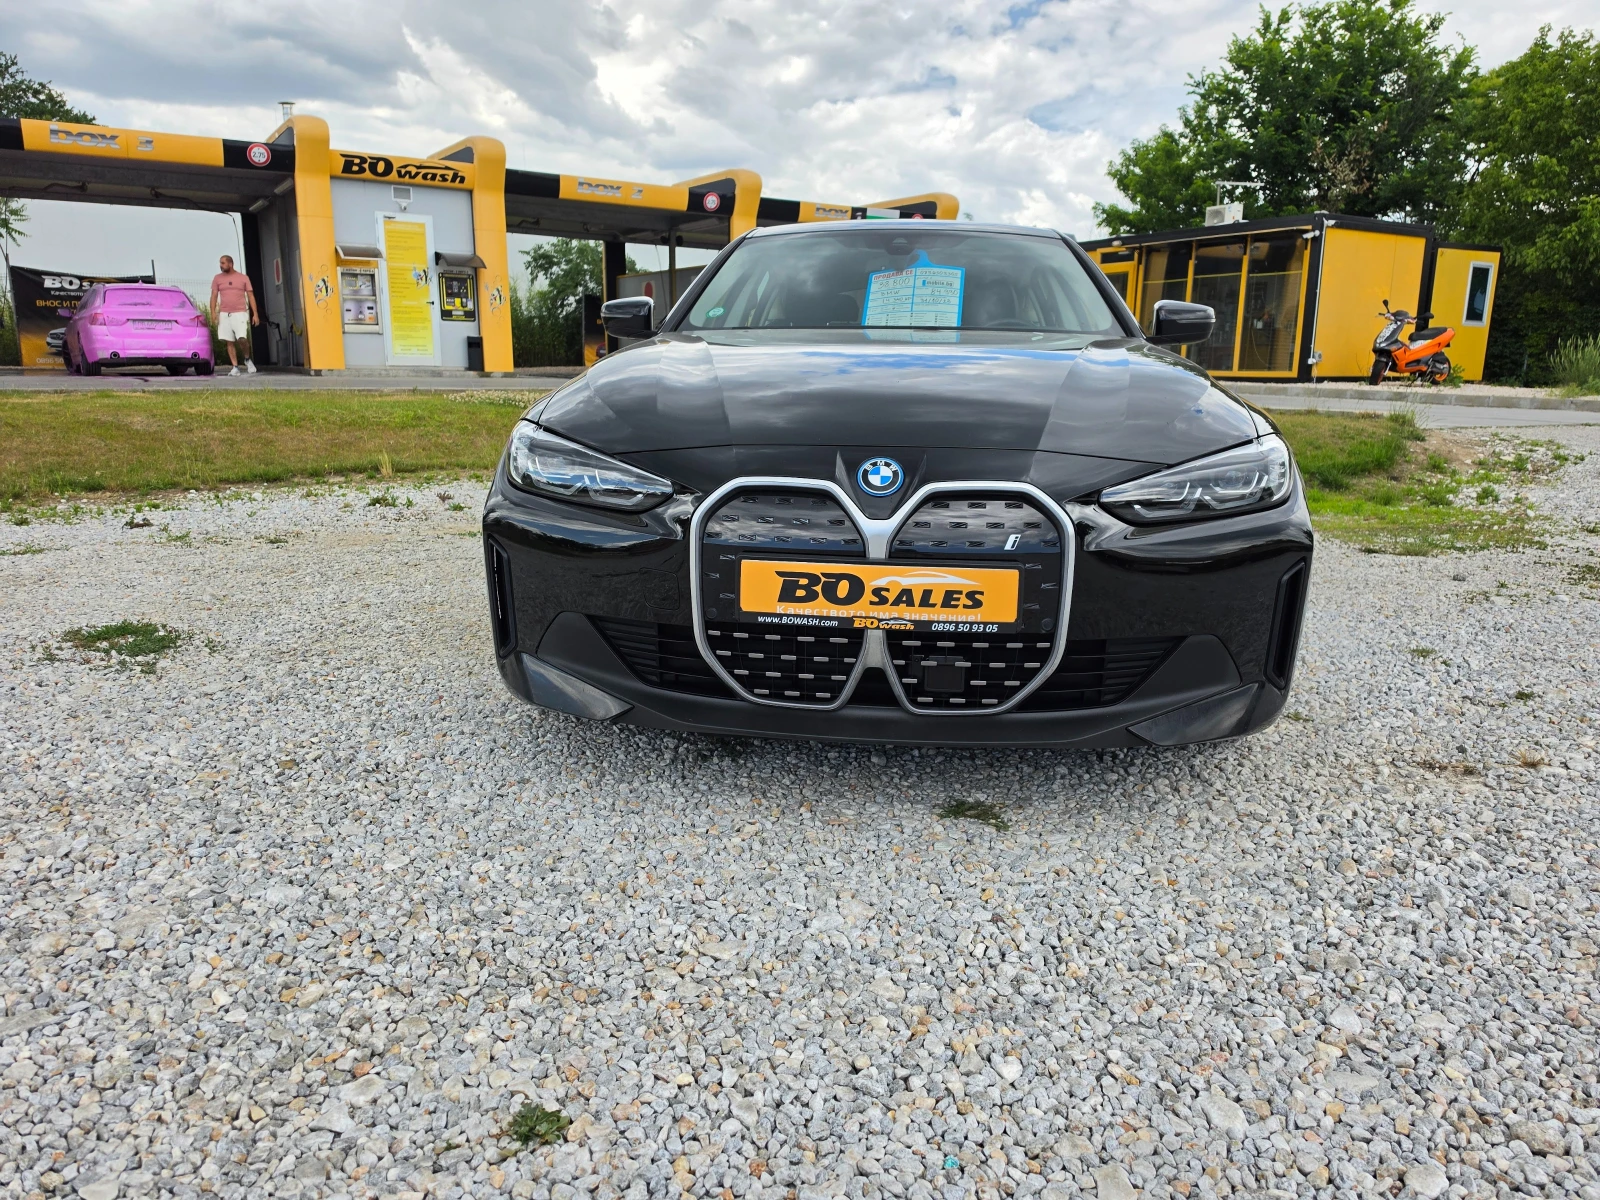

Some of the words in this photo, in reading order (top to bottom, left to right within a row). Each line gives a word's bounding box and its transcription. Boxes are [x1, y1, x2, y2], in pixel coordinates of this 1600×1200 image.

[49, 124, 120, 149] box
[137, 136, 154, 151] 3
[396, 169, 466, 184] wash
[577, 177, 622, 197] box
[631, 186, 643, 199] 2
[36, 299, 61, 307] ВНОС
[774, 570, 866, 606] BO
[869, 587, 985, 609] SALES
[757, 615, 839, 627] www.BOWASH.com
[776, 605, 866, 617] Качеството
[869, 611, 899, 619] има
[902, 612, 982, 622] значение!
[931, 622, 956, 632] 0896
[957, 623, 970, 632] 50
[971, 624, 984, 633] 93
[985, 624, 999, 633] 05
